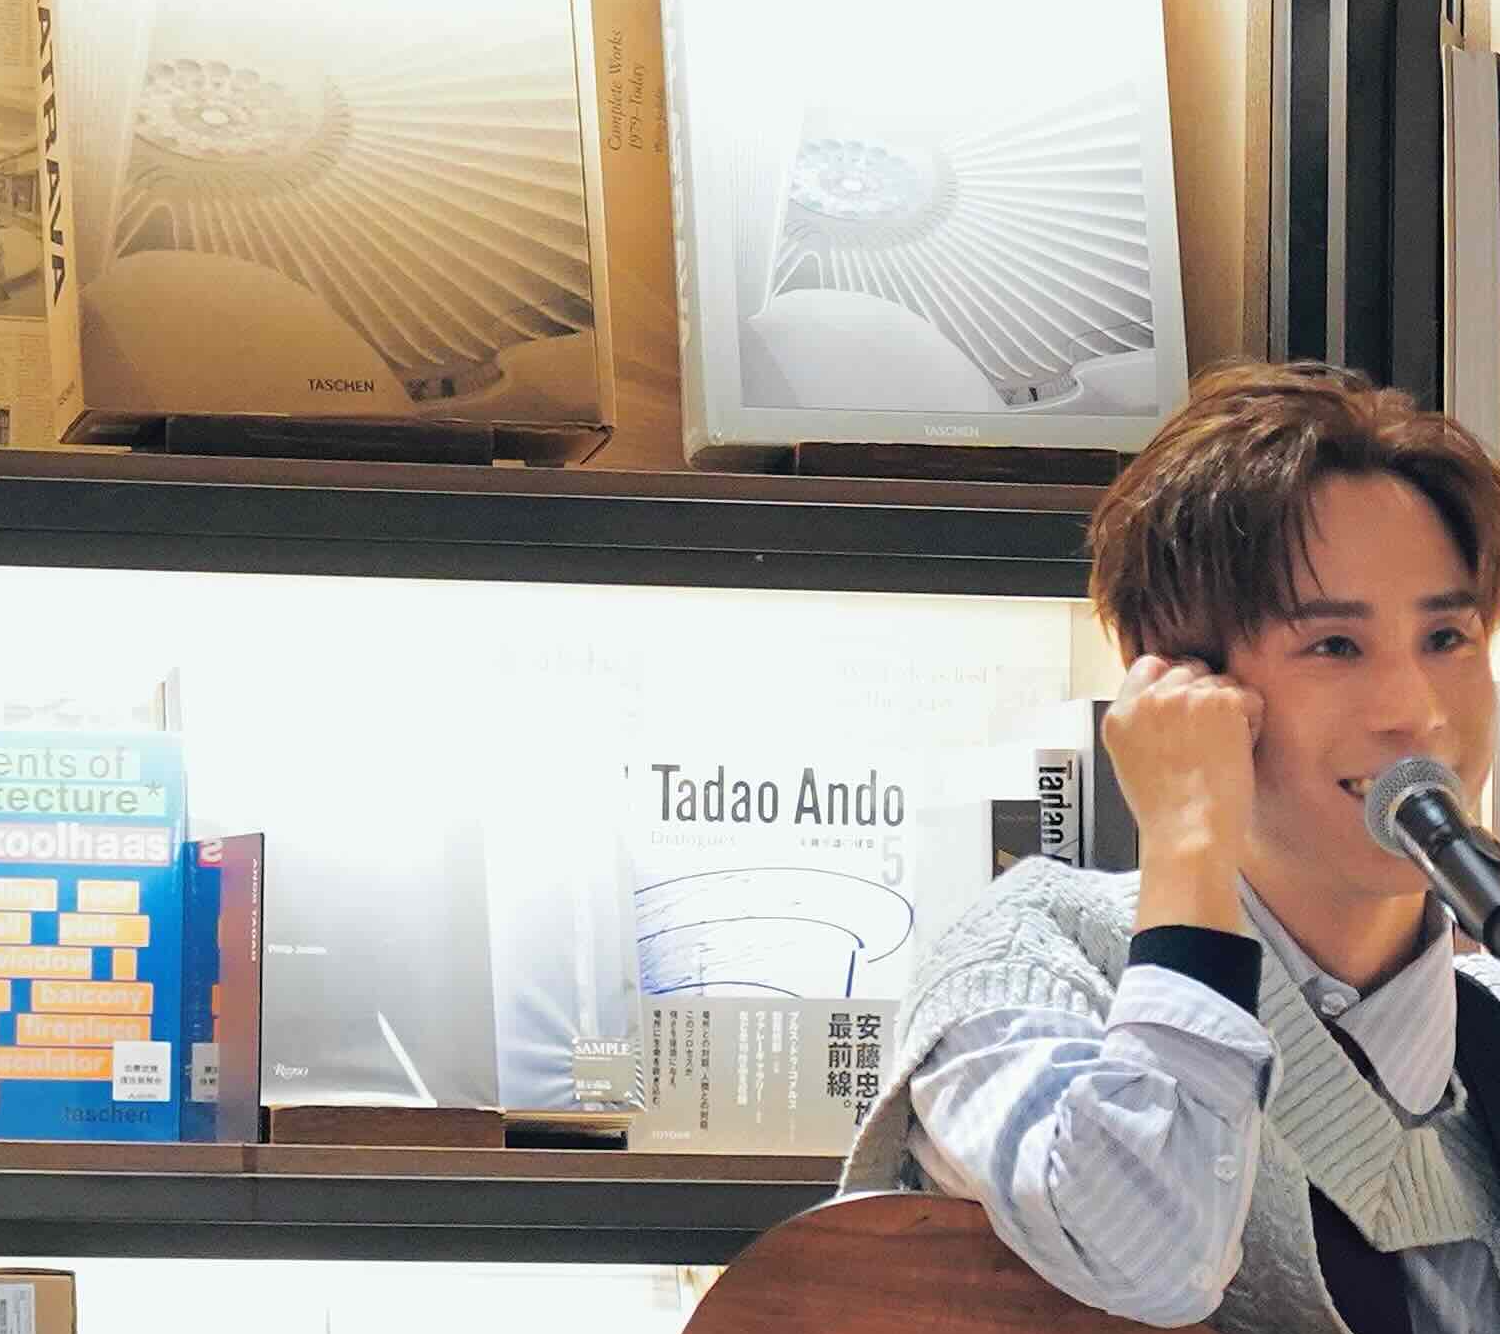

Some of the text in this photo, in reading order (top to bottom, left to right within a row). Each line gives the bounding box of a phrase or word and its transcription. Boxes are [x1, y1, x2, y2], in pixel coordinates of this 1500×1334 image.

[308, 378, 374, 393] TASCHEN
[89, 746, 127, 779] of
[651, 764, 904, 827] Tadao Ando
[827, 1012, 852, 1108] 最前線。
